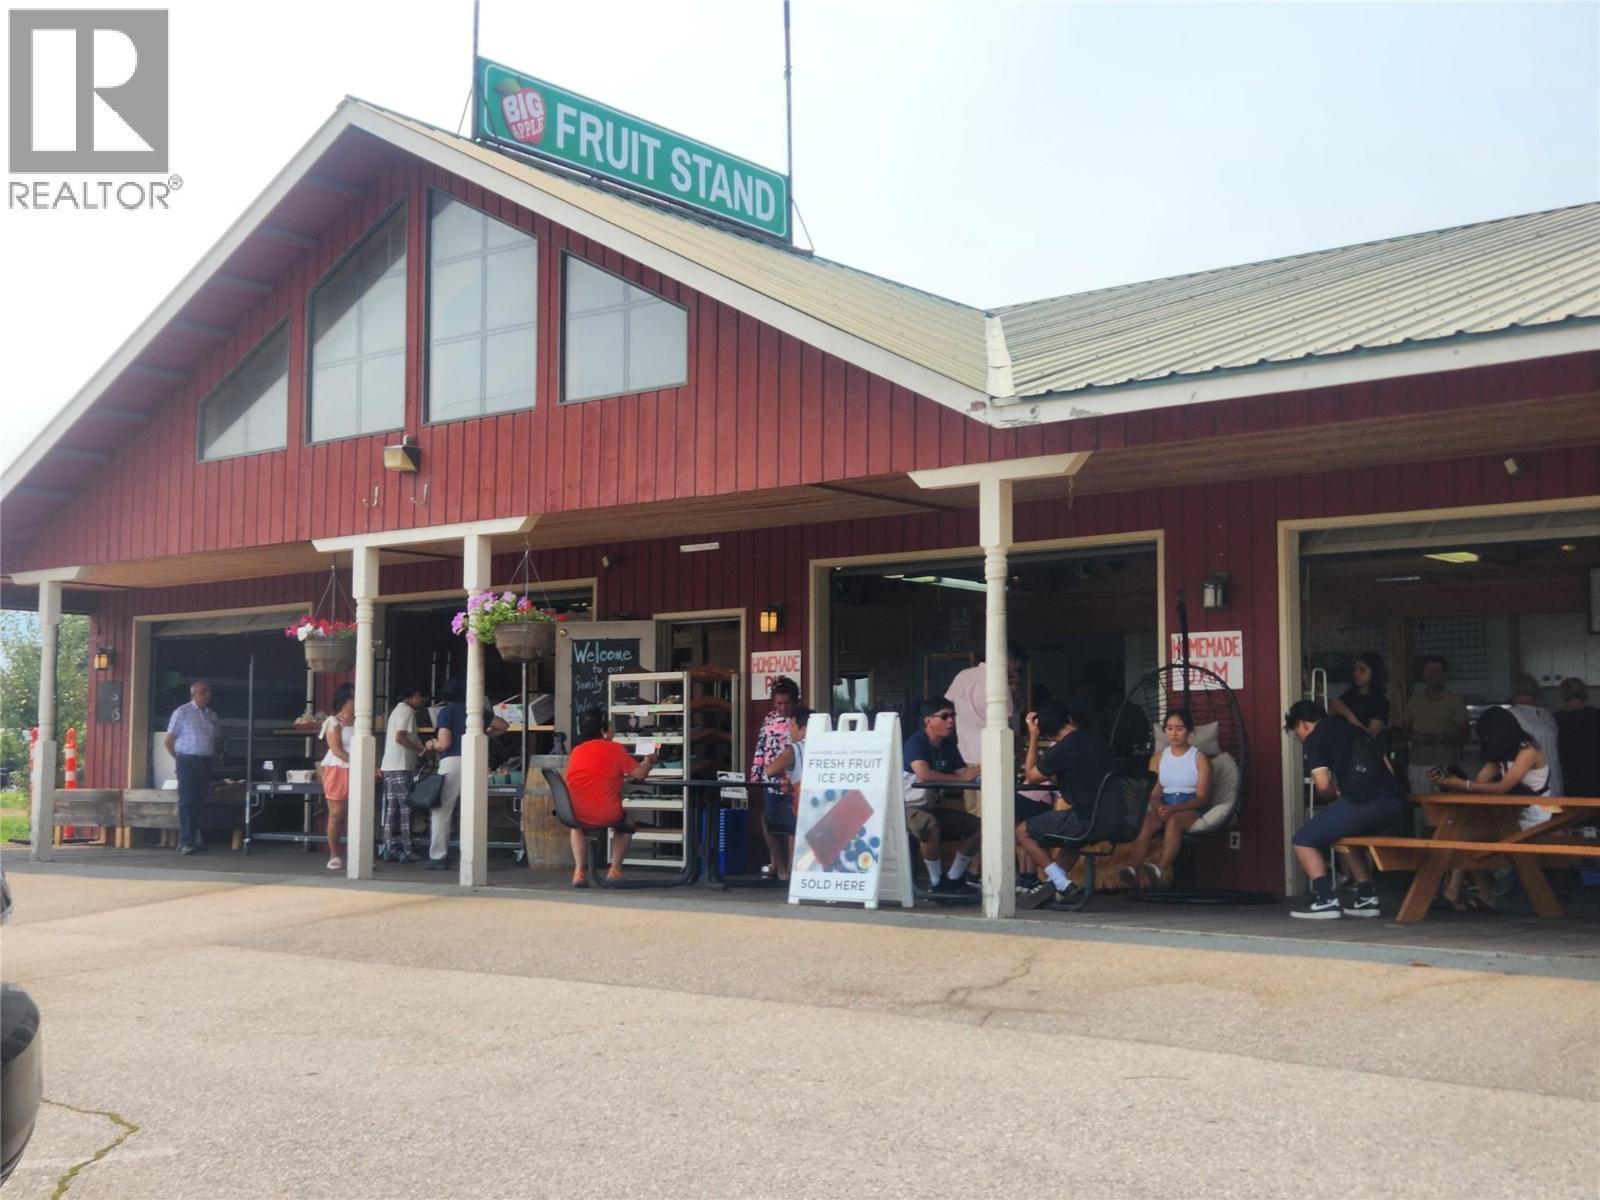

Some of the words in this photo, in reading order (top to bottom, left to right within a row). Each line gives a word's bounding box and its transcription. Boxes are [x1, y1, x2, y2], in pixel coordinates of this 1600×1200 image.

[502, 92, 544, 123] BIG
[511, 117, 544, 139] APPLE
[556, 102, 661, 181] FRUIT
[671, 146, 776, 222] STAND
[573, 641, 633, 664] Welcome
[1171, 636, 1241, 657] HMEMADE
[592, 664, 602, 673] to
[608, 665, 625, 673] our
[752, 655, 800, 674] HOMEMADE
[808, 758, 845, 769] FRESH
[848, 758, 883, 769] FRUIT
[818, 773, 836, 783] ICE
[839, 773, 870, 783] POPS
[801, 878, 832, 890] SOLD
[835, 879, 866, 892] HERE
